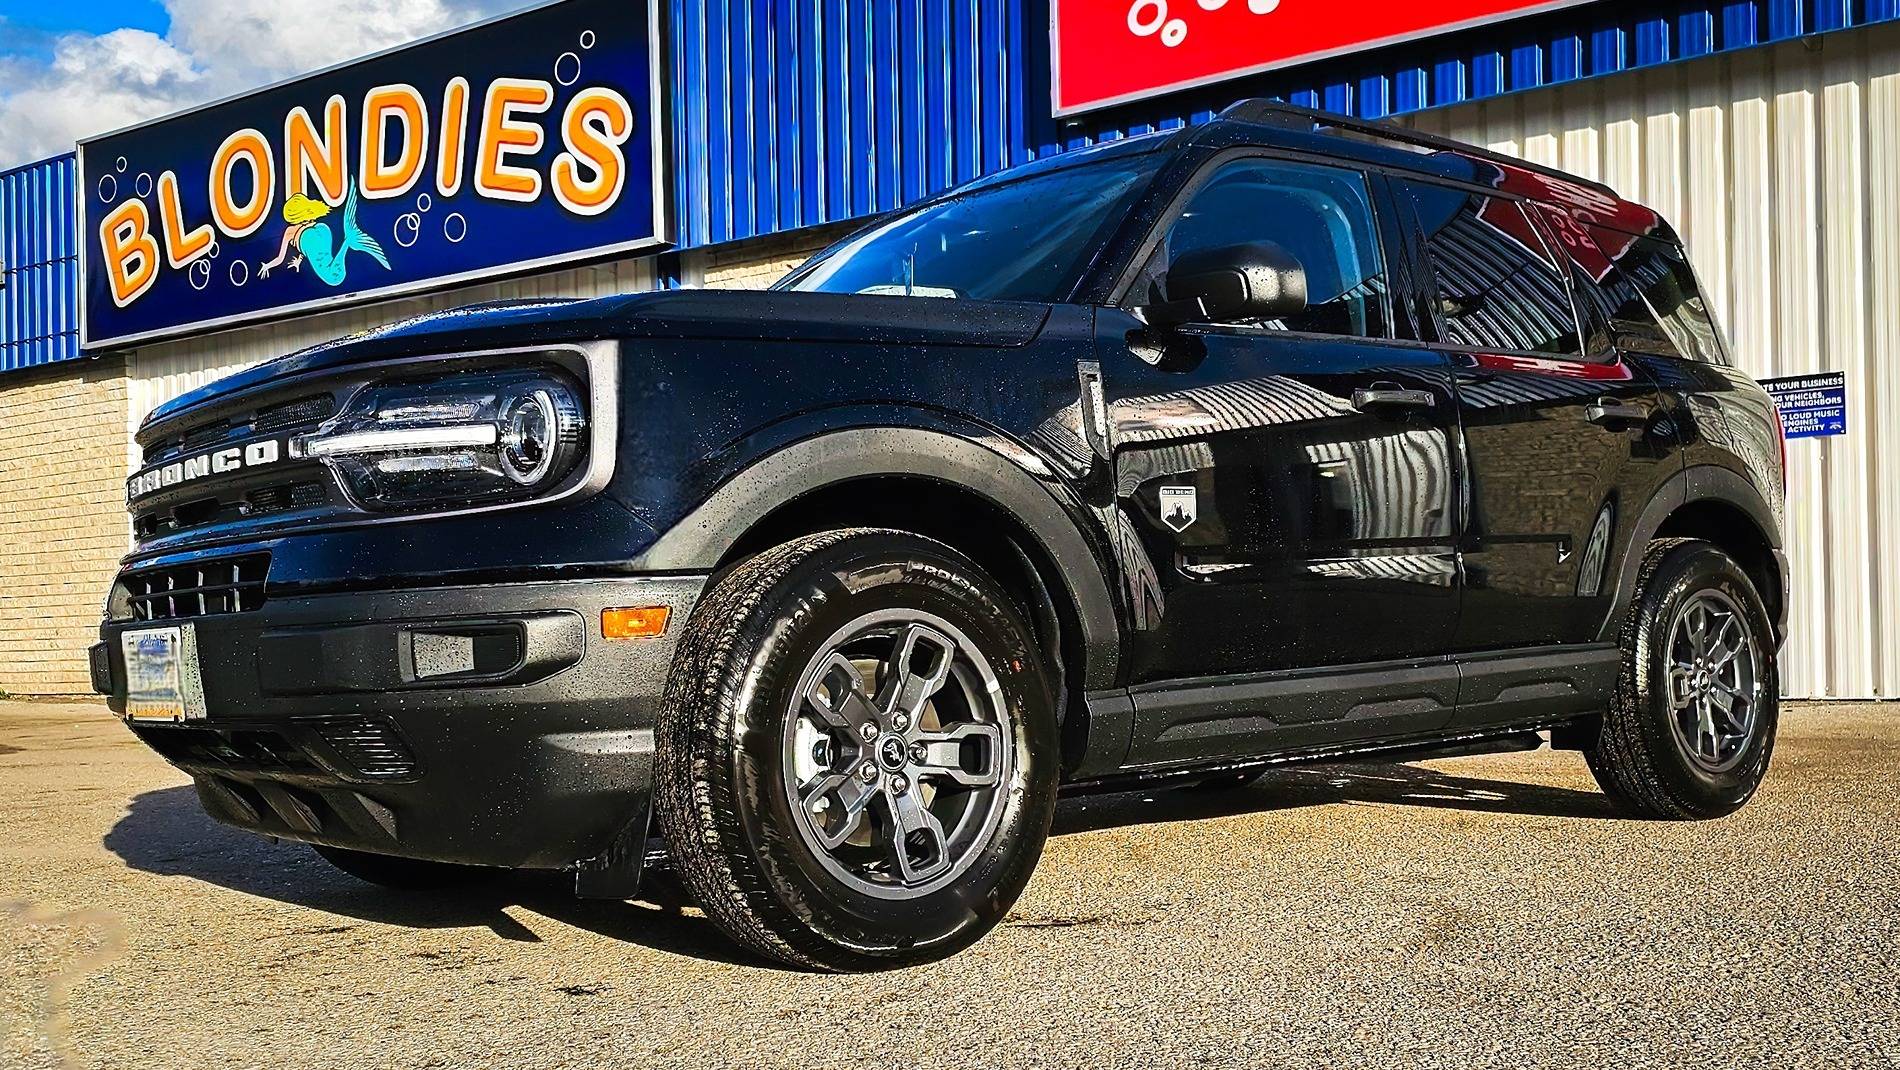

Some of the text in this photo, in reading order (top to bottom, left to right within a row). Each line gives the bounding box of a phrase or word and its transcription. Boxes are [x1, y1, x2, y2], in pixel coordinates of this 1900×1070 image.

[100, 76, 633, 308] BLONDIES
[1775, 381, 1800, 390] YOUR
[1801, 377, 1843, 388] BUSINESS
[1794, 396, 1842, 407] NEIGHBORS
[1788, 412, 1812, 420] LOUD
[1814, 410, 1840, 418] MUSIC
[1787, 424, 1825, 433] ACTIVITY
[129, 439, 279, 498] BRONCO
